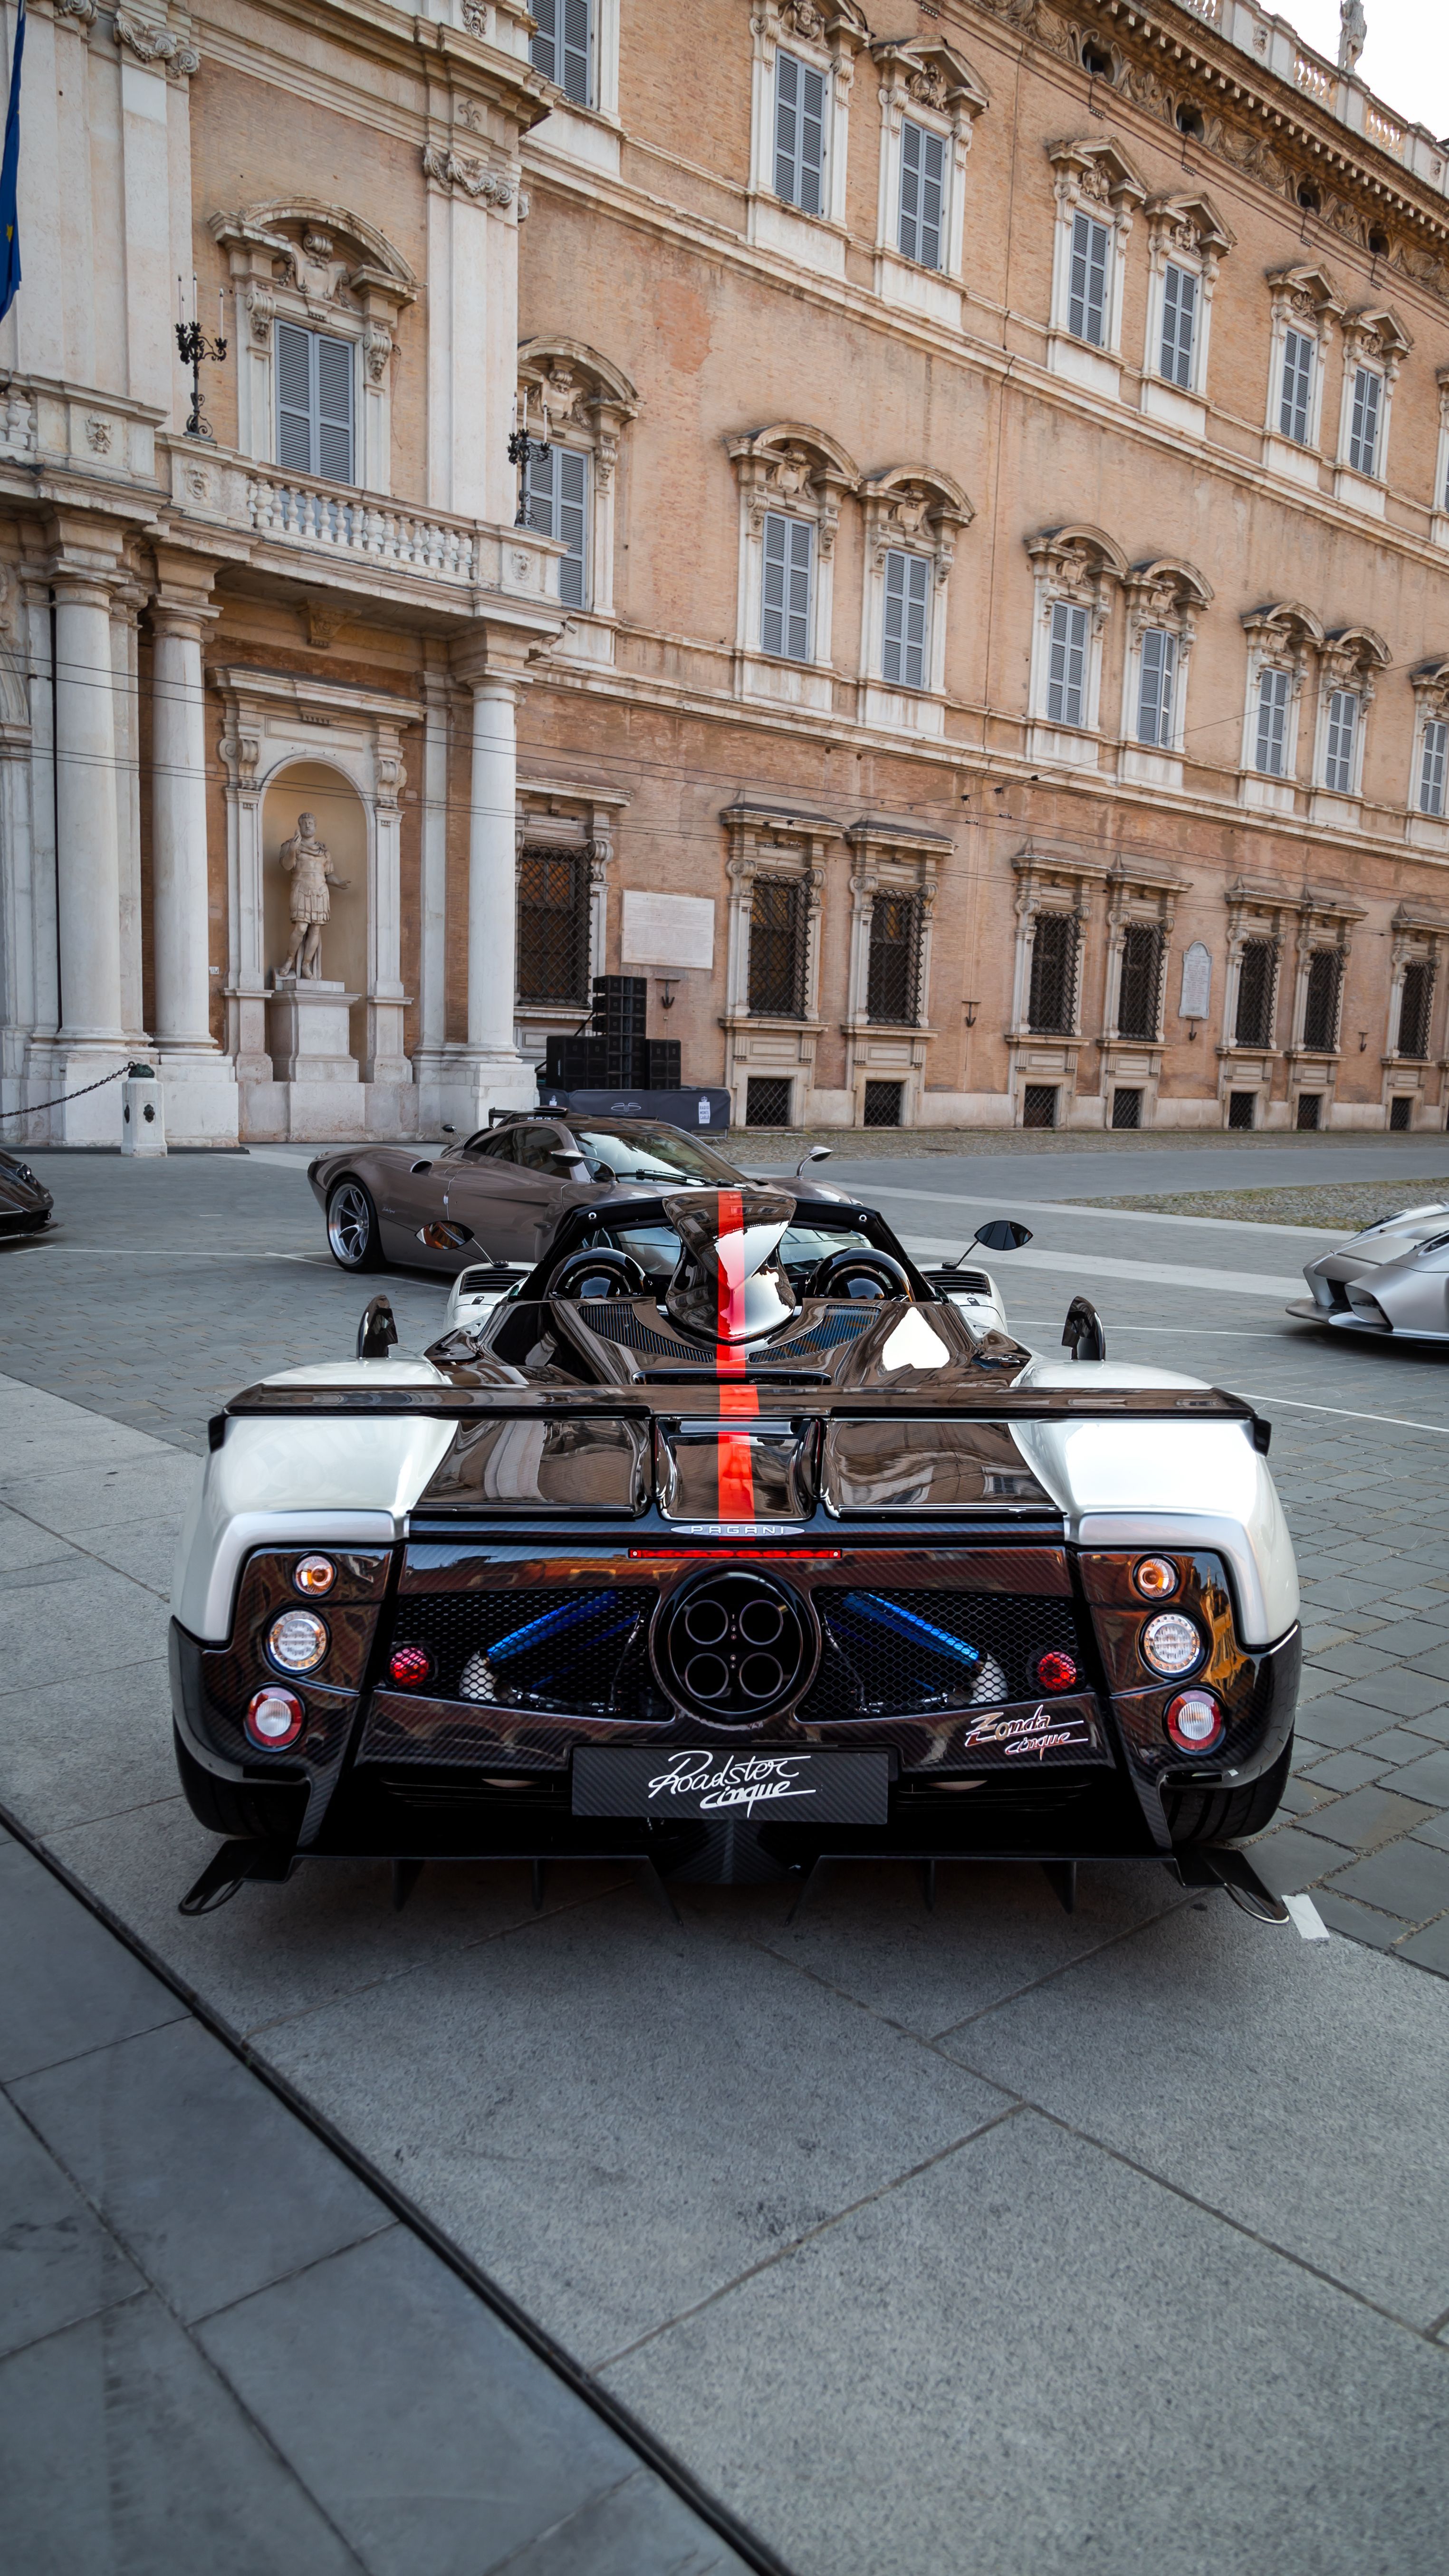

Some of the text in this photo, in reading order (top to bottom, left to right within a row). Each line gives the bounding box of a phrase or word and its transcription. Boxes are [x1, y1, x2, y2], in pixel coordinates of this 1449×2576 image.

[691, 1526, 784, 1534] PAGANI
[965, 1705, 1084, 1747] Zonda
[1005, 1732, 1088, 1761] cinque
[648, 1751, 811, 1798] Roadster
[700, 1781, 816, 1818] cinque
